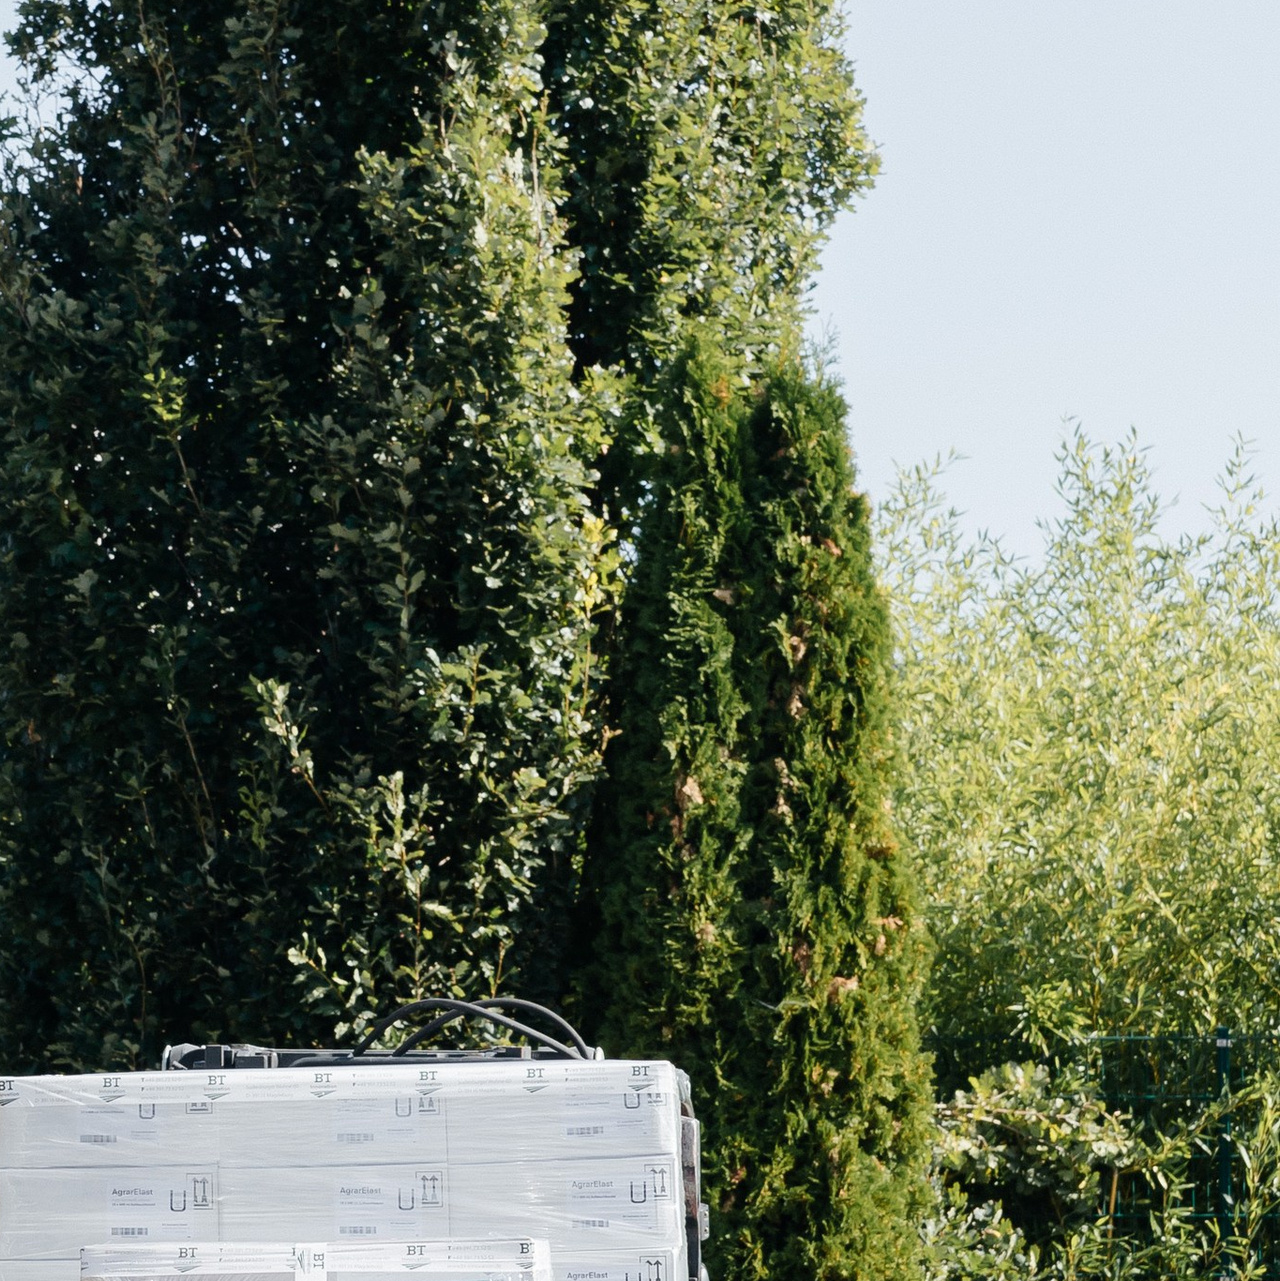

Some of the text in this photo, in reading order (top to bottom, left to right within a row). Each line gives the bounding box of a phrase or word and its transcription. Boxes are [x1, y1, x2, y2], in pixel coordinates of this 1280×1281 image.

[419, 1071, 438, 1081] BT
[527, 1068, 545, 1078] BT
[632, 1066, 650, 1076] BT
[103, 1077, 121, 1088] BT
[208, 1075, 226, 1085] BT
[314, 1073, 332, 1083] BT
[572, 1180, 613, 1189] AgrarElast
[112, 1188, 153, 1197] AgrarElast
[340, 1186, 381, 1195] AgrarElast
[178, 1247, 198, 1258] BT
[406, 1245, 426, 1256] BT
[313, 1253, 324, 1270] BT
[567, 1272, 608, 1281] AgrarElast
